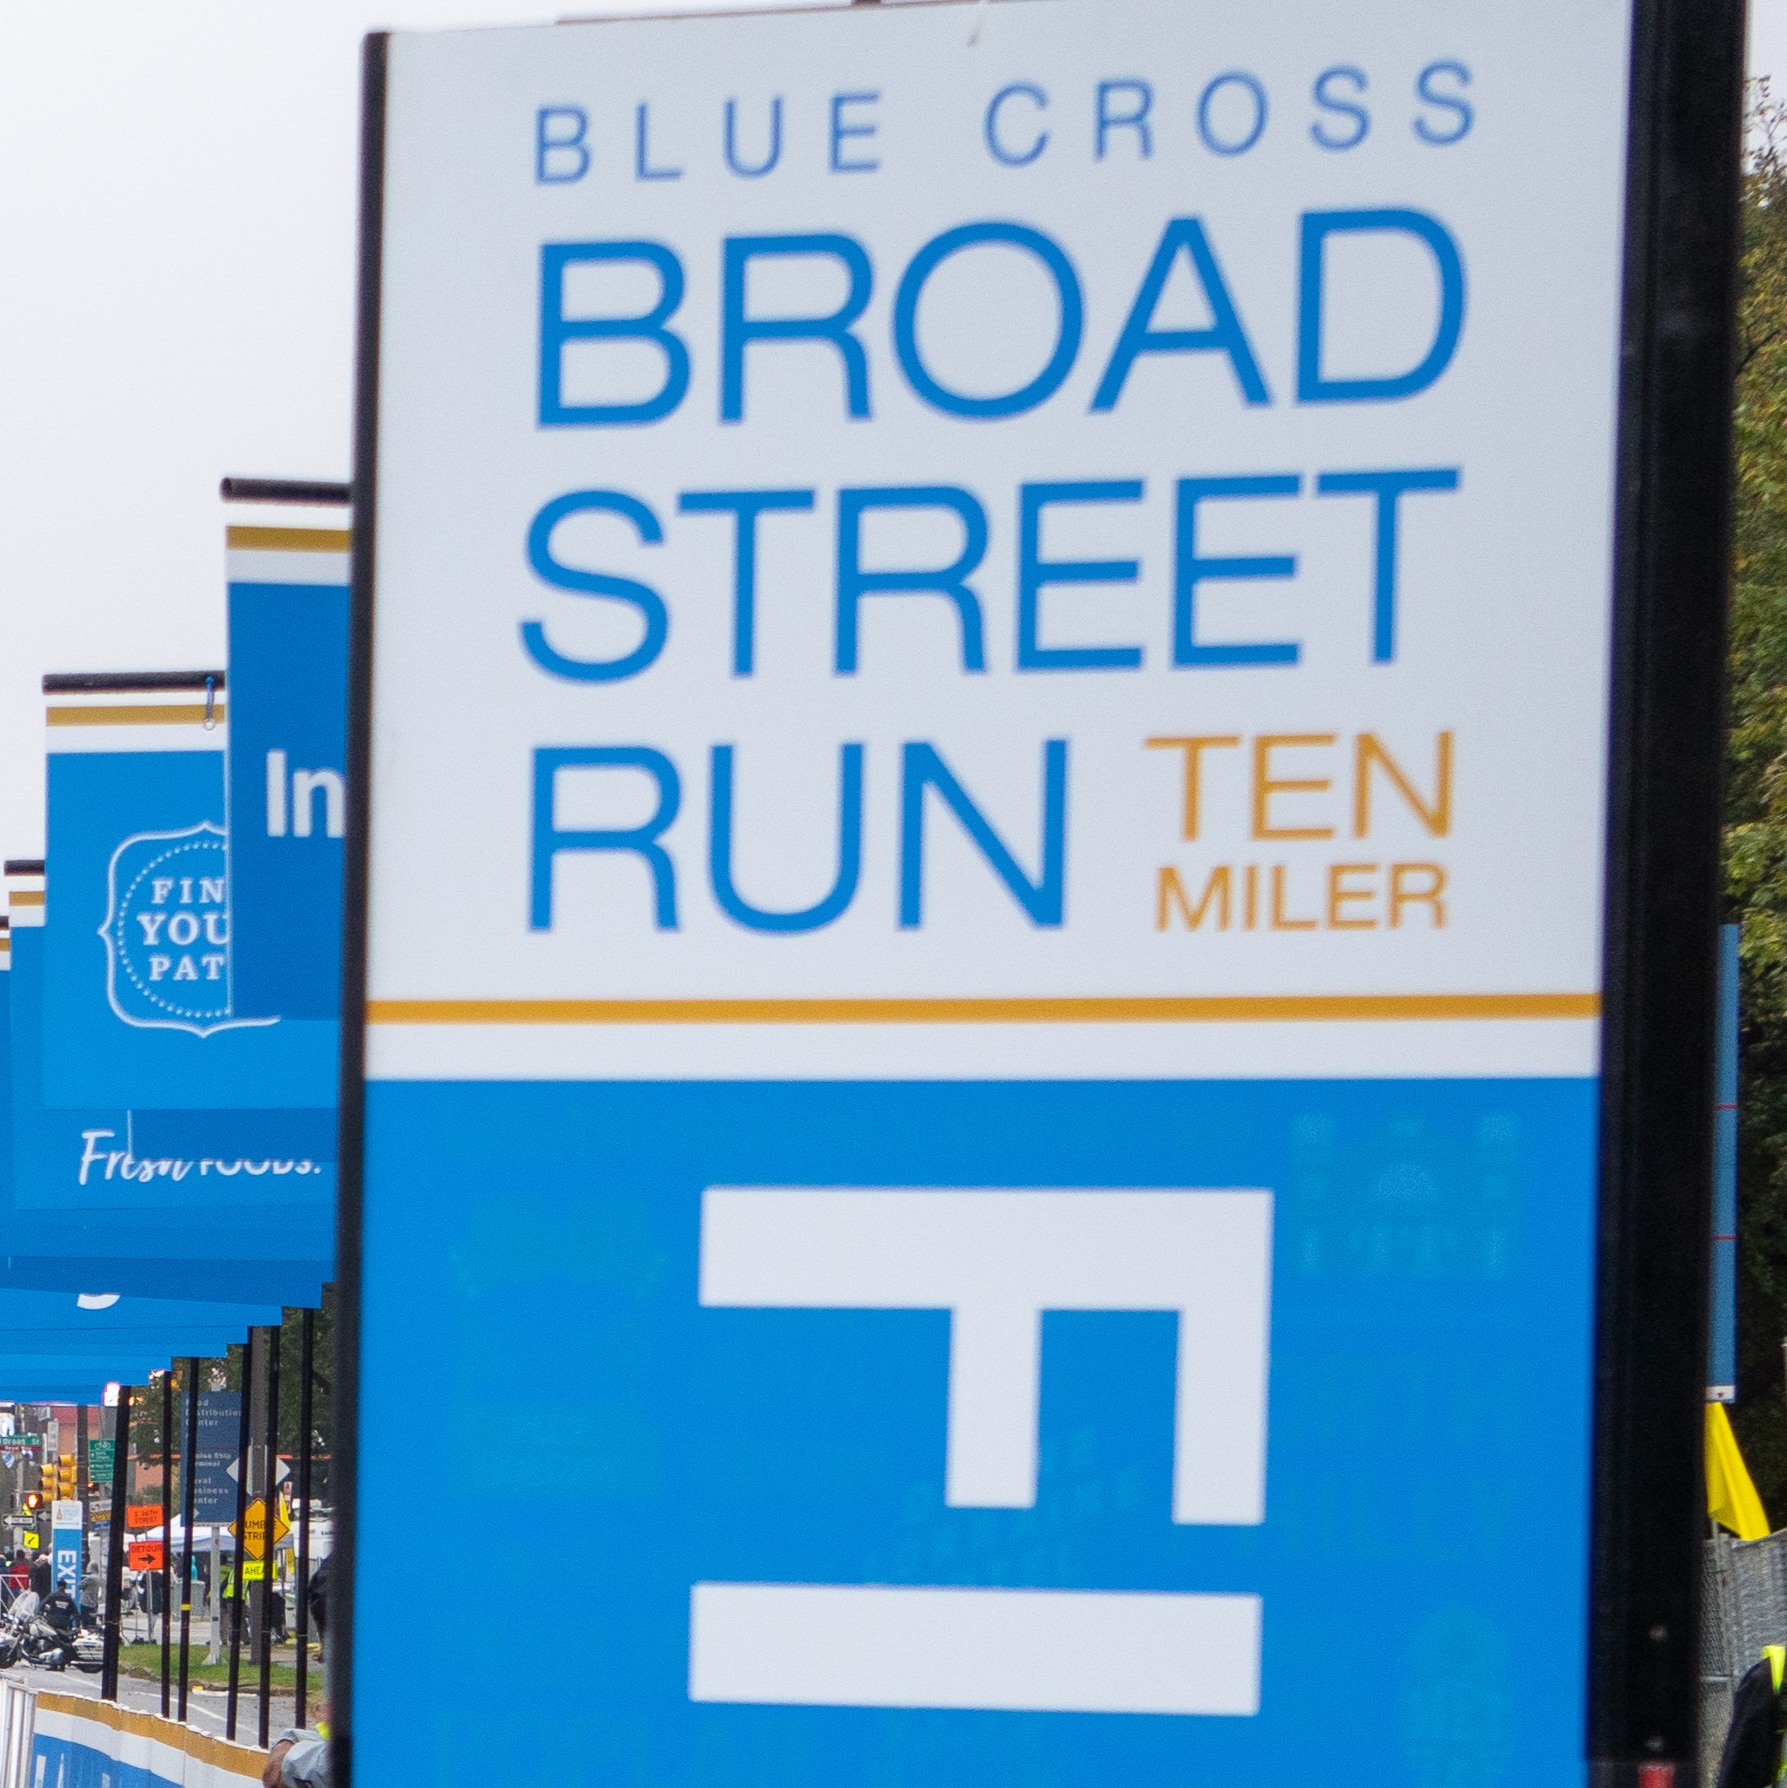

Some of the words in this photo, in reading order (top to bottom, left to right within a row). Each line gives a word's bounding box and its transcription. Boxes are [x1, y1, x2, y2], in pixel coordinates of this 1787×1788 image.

[534, 91, 880, 185] BLUE
[982, 58, 1476, 168] CROSS
[534, 203, 1469, 430] BROAD
[518, 464, 1463, 686] STREET
[526, 736, 1070, 938] RUN
[1144, 730, 1455, 842] TEN
[1157, 861, 1448, 932] MILER
[57, 1550, 77, 1599] EXIT
[131, 1544, 163, 1553] DETOUR
